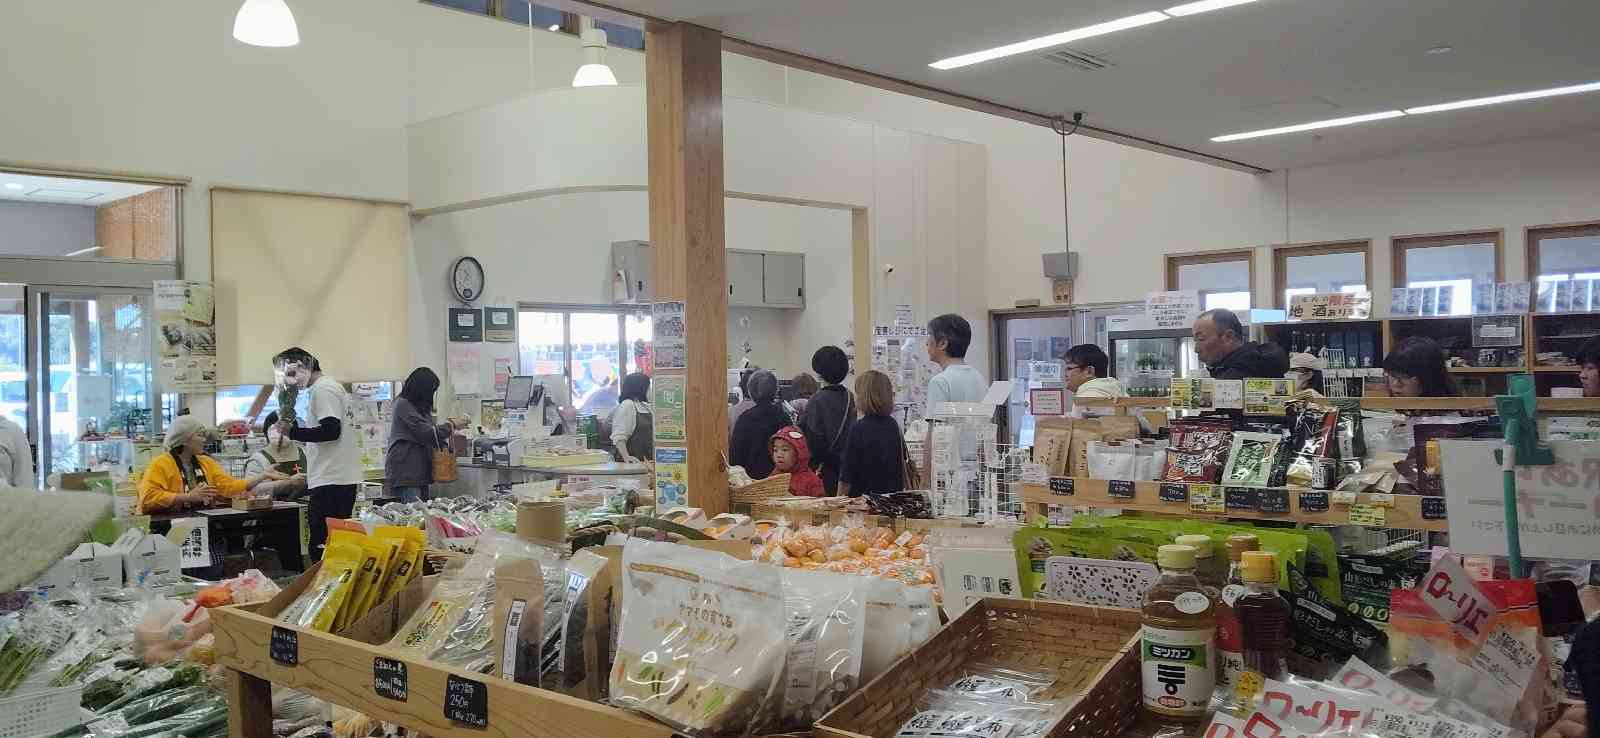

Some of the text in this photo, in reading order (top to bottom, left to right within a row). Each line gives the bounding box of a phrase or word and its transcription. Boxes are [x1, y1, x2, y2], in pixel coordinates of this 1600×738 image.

[1427, 571, 1489, 635] ローリエ
[1152, 645, 1191, 659] ミツカン
